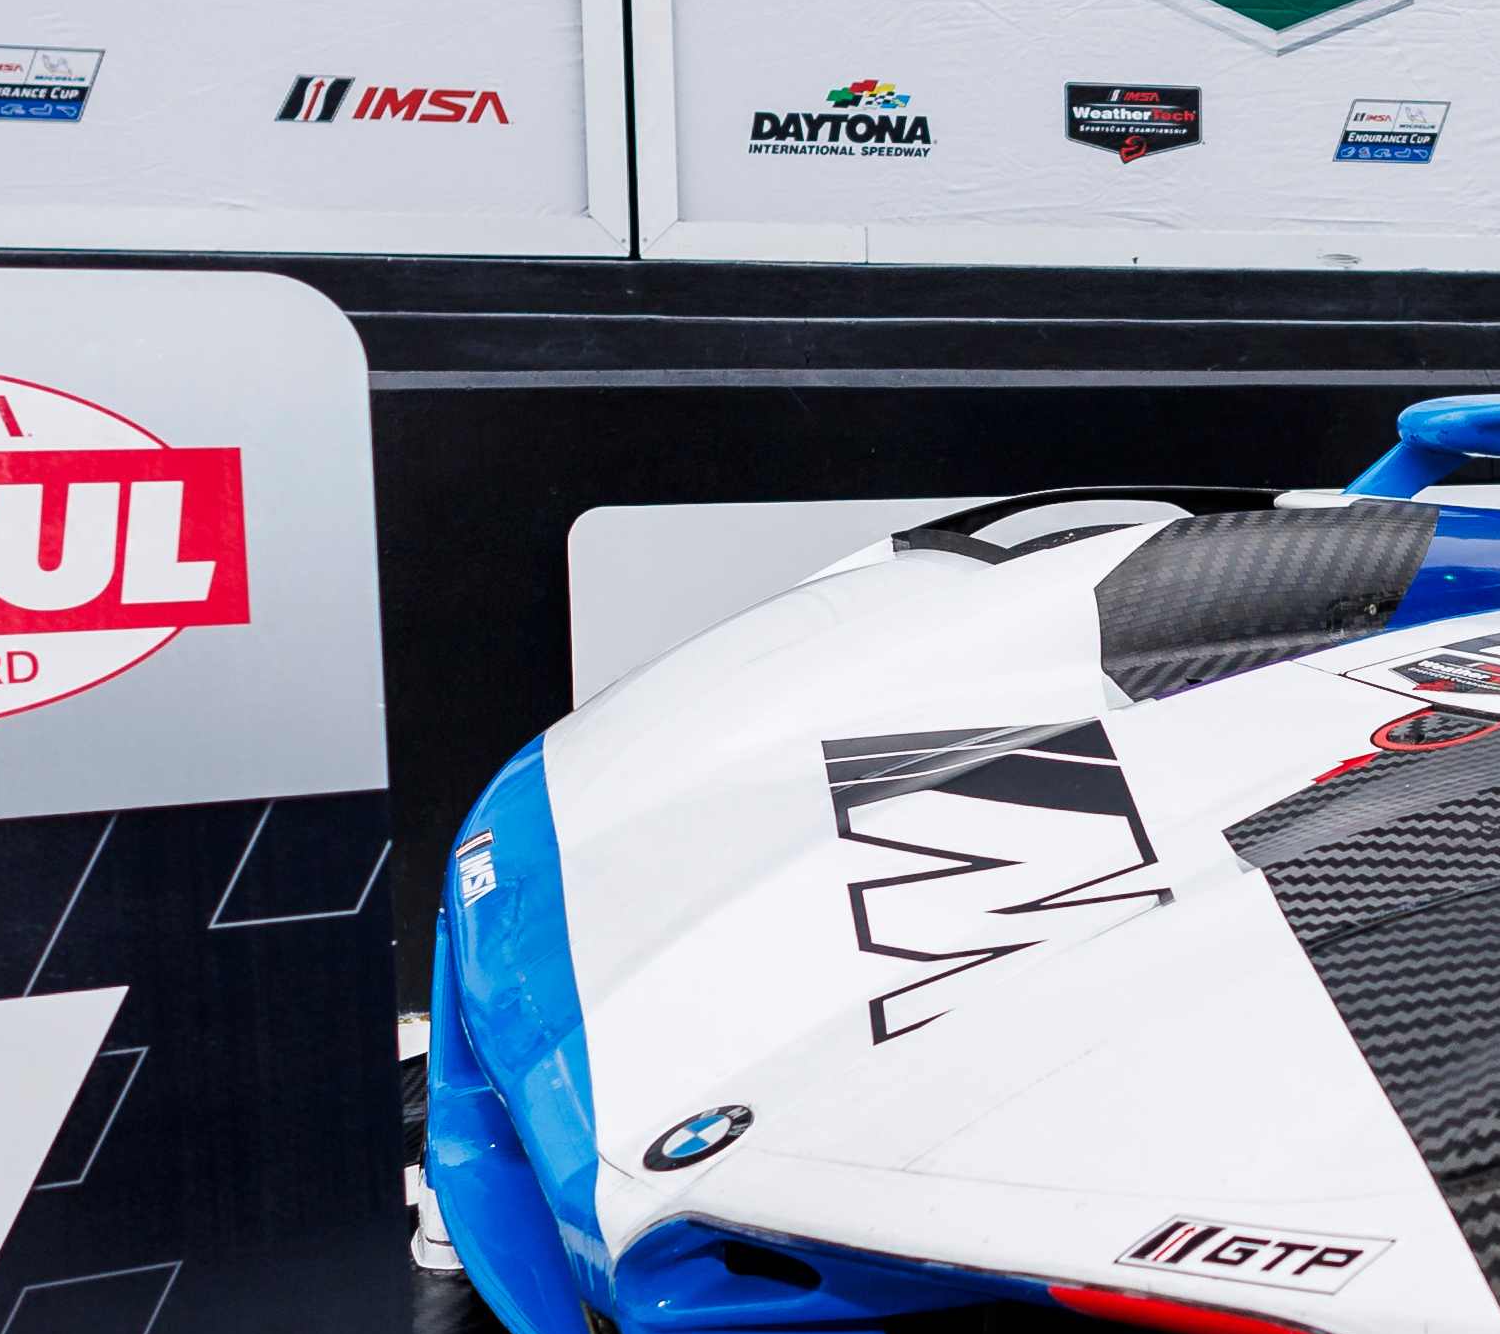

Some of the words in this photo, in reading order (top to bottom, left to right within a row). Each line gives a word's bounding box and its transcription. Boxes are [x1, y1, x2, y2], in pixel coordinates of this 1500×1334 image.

[350, 87, 512, 124] IMSA
[1072, 106, 1195, 122] WeatherTech
[750, 110, 931, 146] DAYTONA
[749, 143, 856, 157] INTERNATIONAL
[862, 145, 931, 159] SPEEDWAY
[1203, 1232, 1365, 1280] GTP
